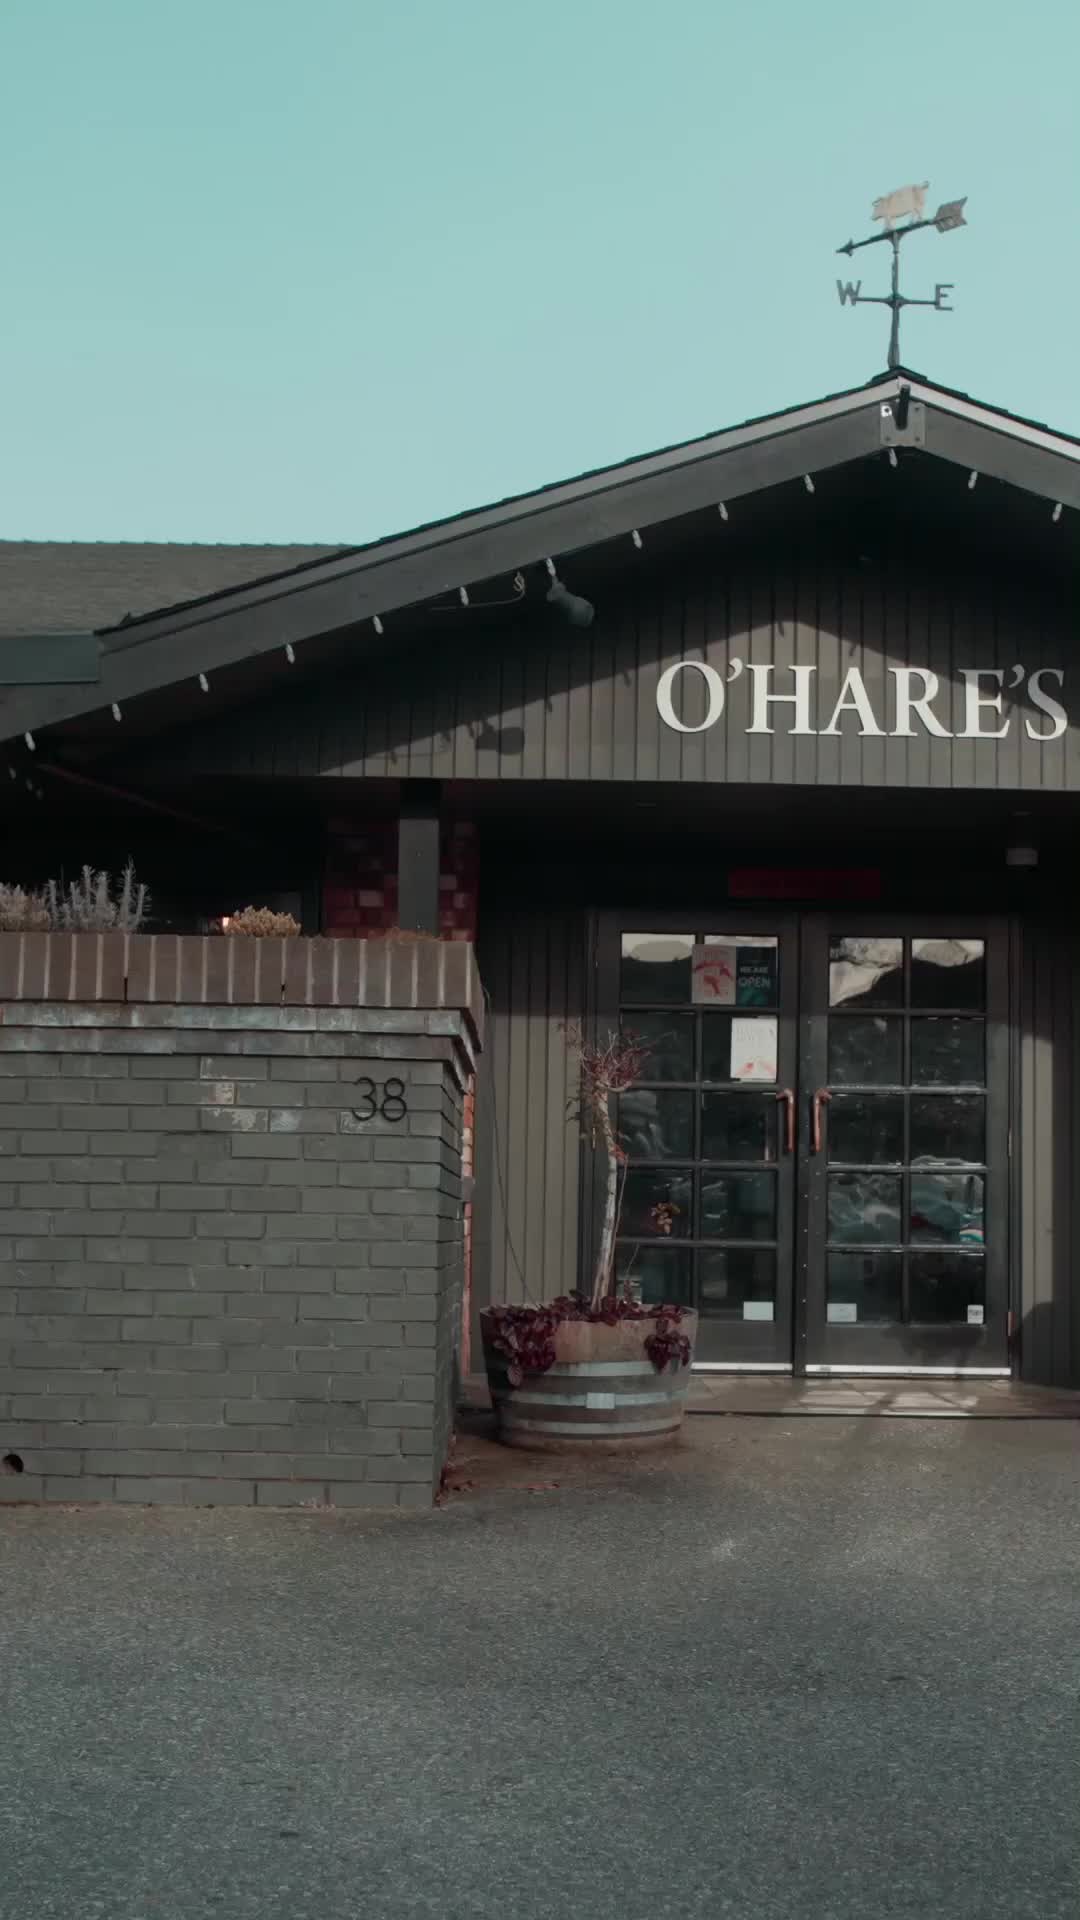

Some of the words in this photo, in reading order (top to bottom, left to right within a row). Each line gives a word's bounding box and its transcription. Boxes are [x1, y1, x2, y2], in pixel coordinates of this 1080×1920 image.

[836, 279, 861, 306] W
[934, 283, 955, 311] E
[656, 657, 1069, 741] O'HARE'S
[738, 976, 772, 989] OPEN
[352, 1076, 407, 1122] 38
